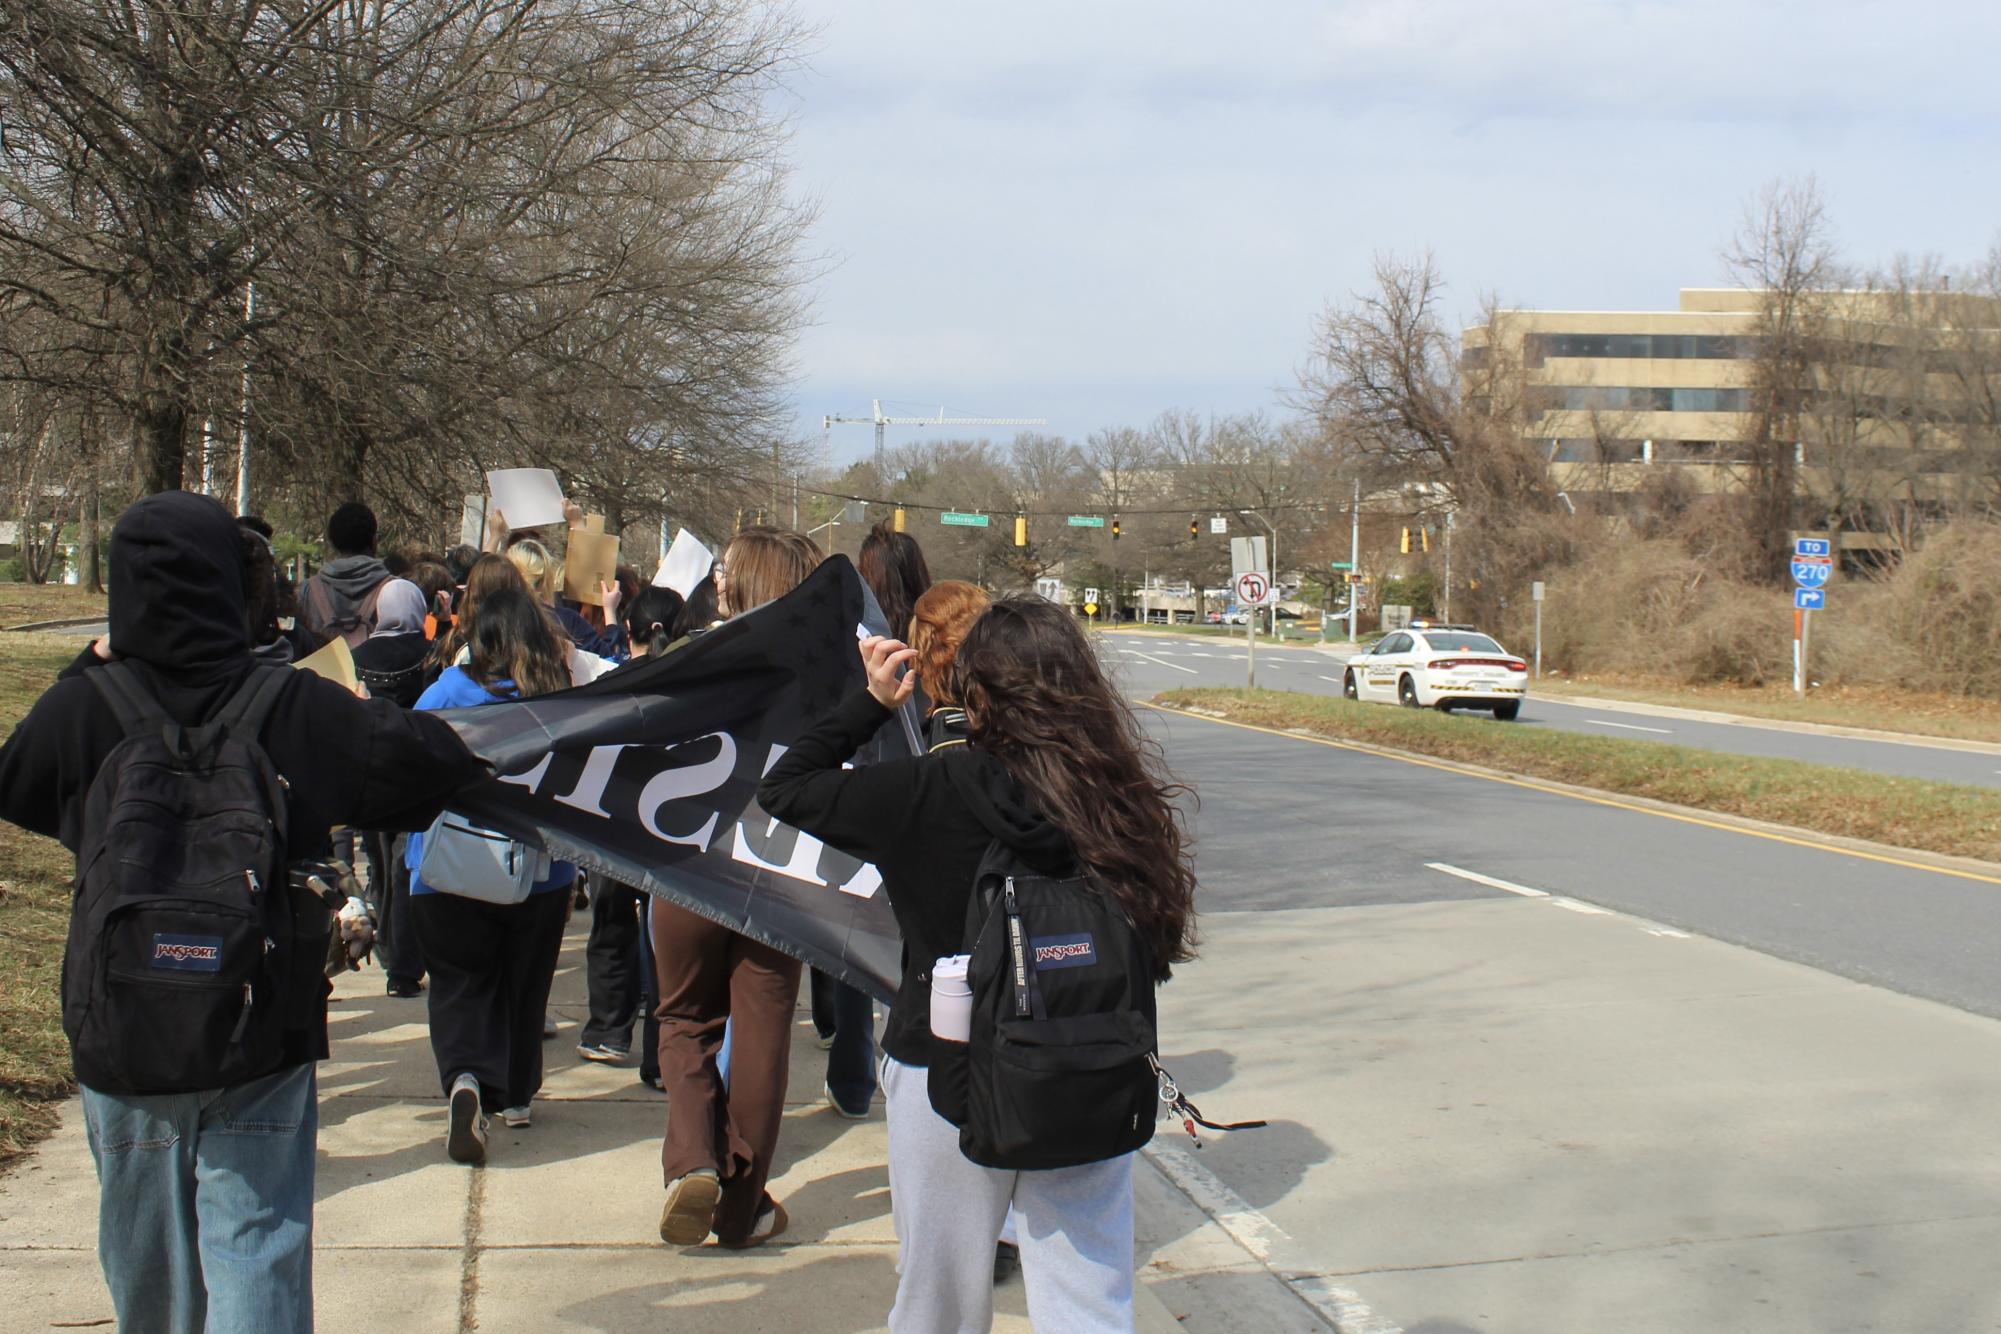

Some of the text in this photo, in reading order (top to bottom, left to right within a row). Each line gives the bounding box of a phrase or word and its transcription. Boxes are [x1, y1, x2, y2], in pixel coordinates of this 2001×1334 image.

[1804, 542, 1821, 553] TO
[1798, 564, 1829, 580] 270
[154, 943, 217, 961] JANSPORT
[1036, 942, 1091, 963] JANSPORT
